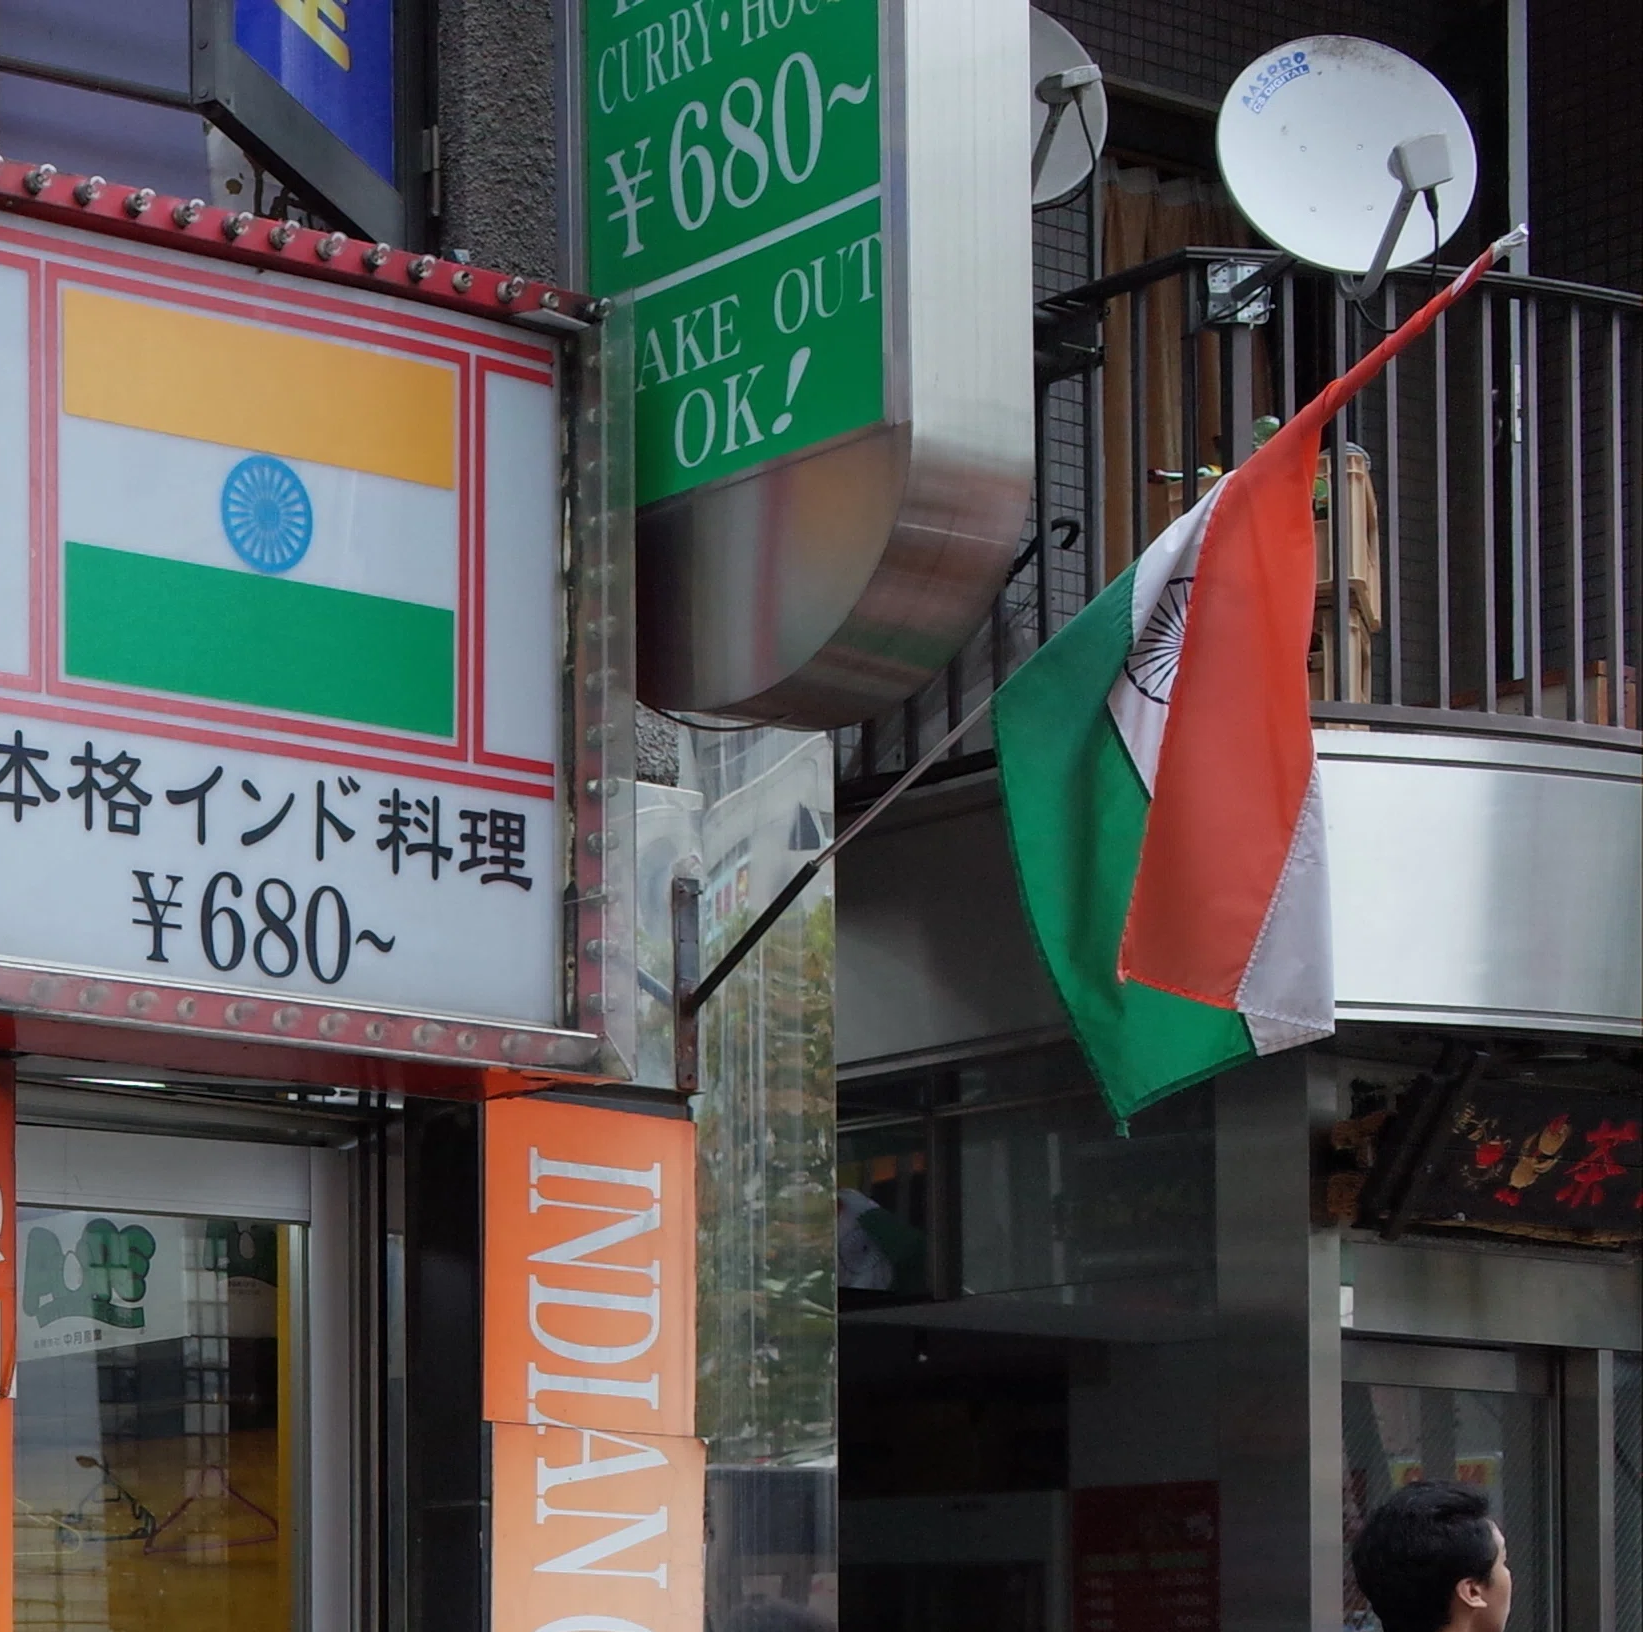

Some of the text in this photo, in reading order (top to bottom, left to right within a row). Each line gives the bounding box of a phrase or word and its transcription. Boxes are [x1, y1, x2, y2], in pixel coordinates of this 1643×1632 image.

[1264, 64, 1309, 96] DIGITAL
[637, 232, 883, 392] AKE OUT
[674, 347, 811, 468] OK!
[527, 1145, 669, 1589] INDIAN
